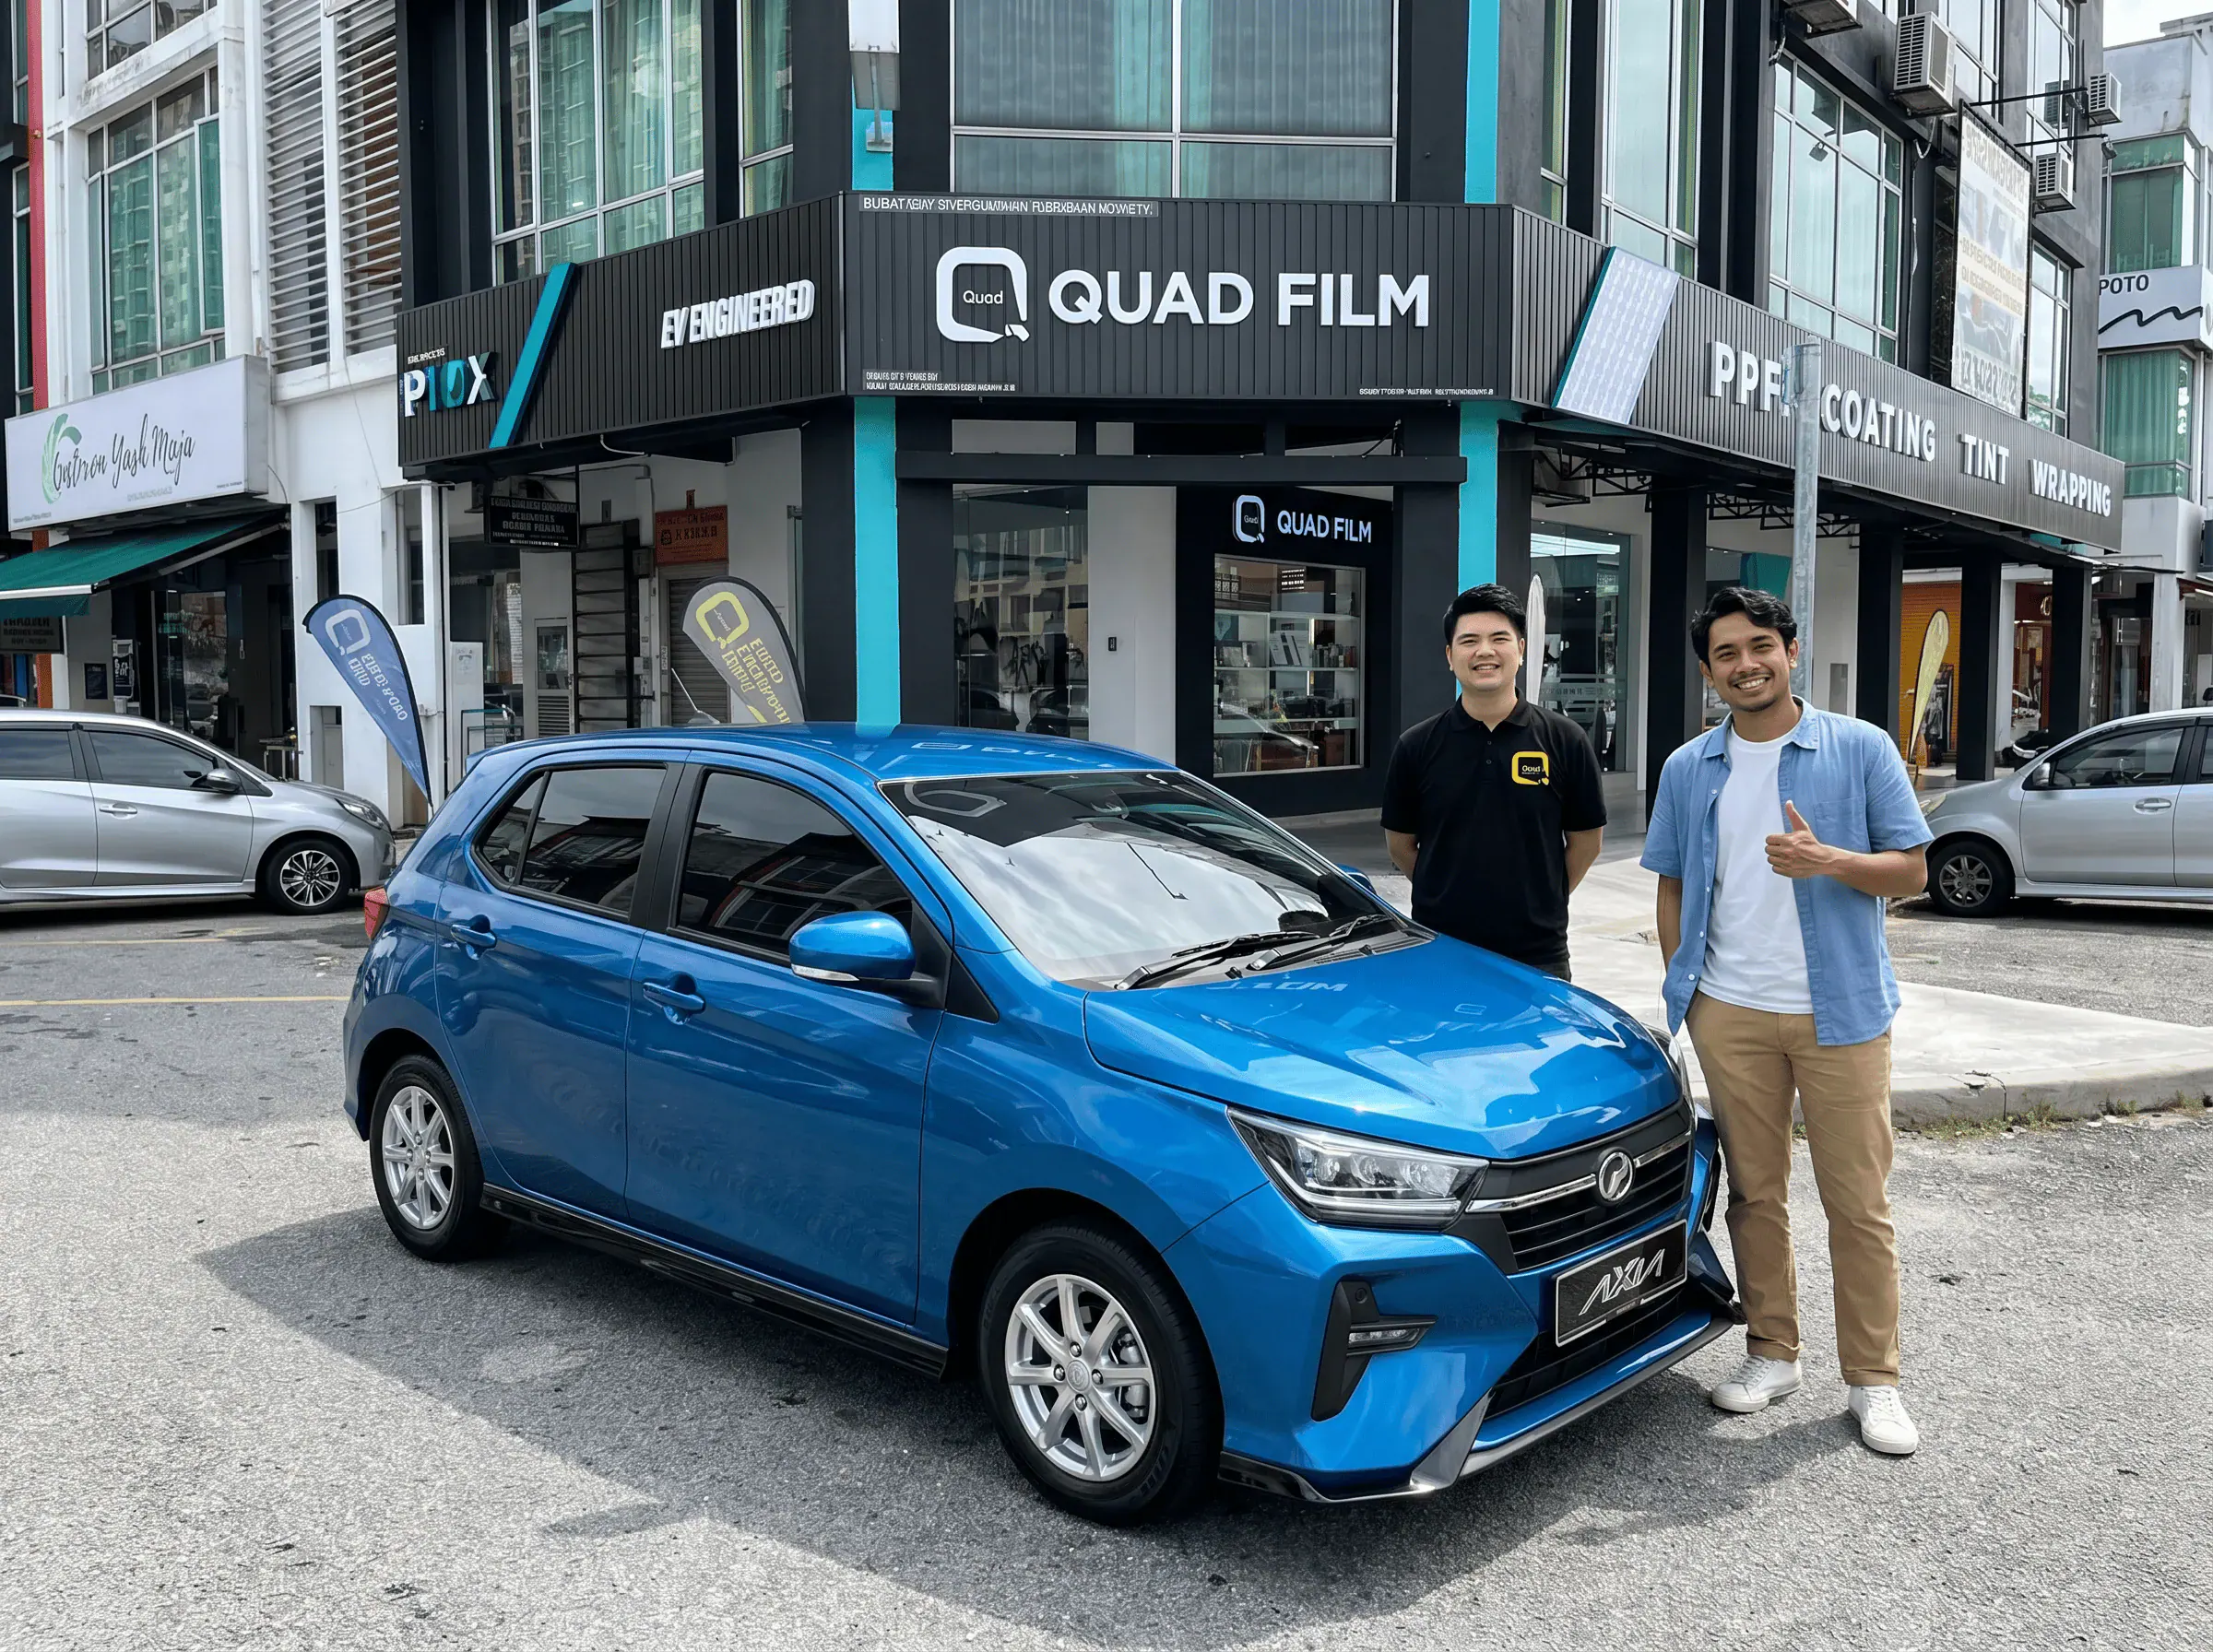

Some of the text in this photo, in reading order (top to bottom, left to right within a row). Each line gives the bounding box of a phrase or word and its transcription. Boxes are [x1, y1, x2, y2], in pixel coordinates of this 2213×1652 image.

[660, 279, 815, 349] EV ENGINEERED
[962, 290, 1003, 304] Quad
[1047, 269, 1429, 327] QUAD FILM
[1820, 384, 1936, 462] COATING
[1960, 433, 2010, 485] TINT
[2030, 458, 2112, 517] WRAPPING
[1277, 510, 1372, 543] QUAD FILM
